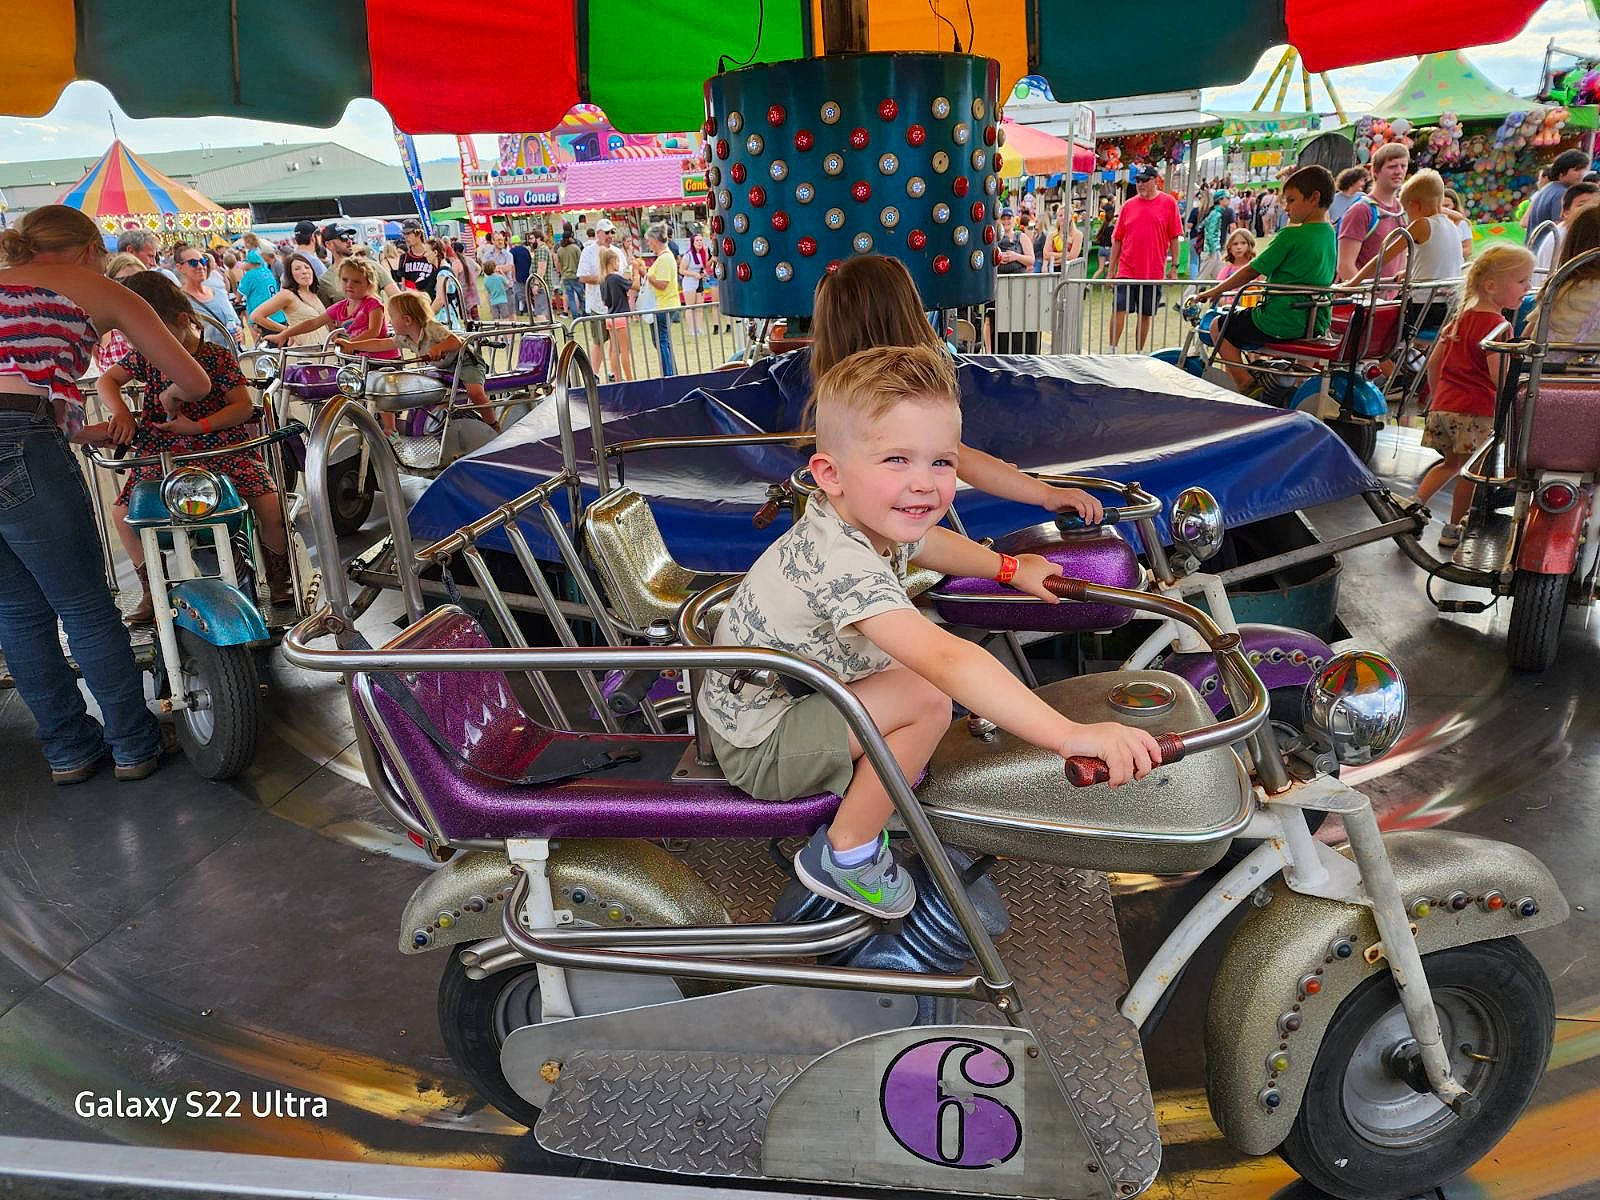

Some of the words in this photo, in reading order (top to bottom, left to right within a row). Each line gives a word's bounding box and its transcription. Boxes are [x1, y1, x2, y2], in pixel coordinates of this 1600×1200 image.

[498, 192, 520, 206] Sno
[524, 189, 558, 205] Cones
[405, 261, 433, 274] BLAZERS
[879, 1037, 1022, 1169] 6
